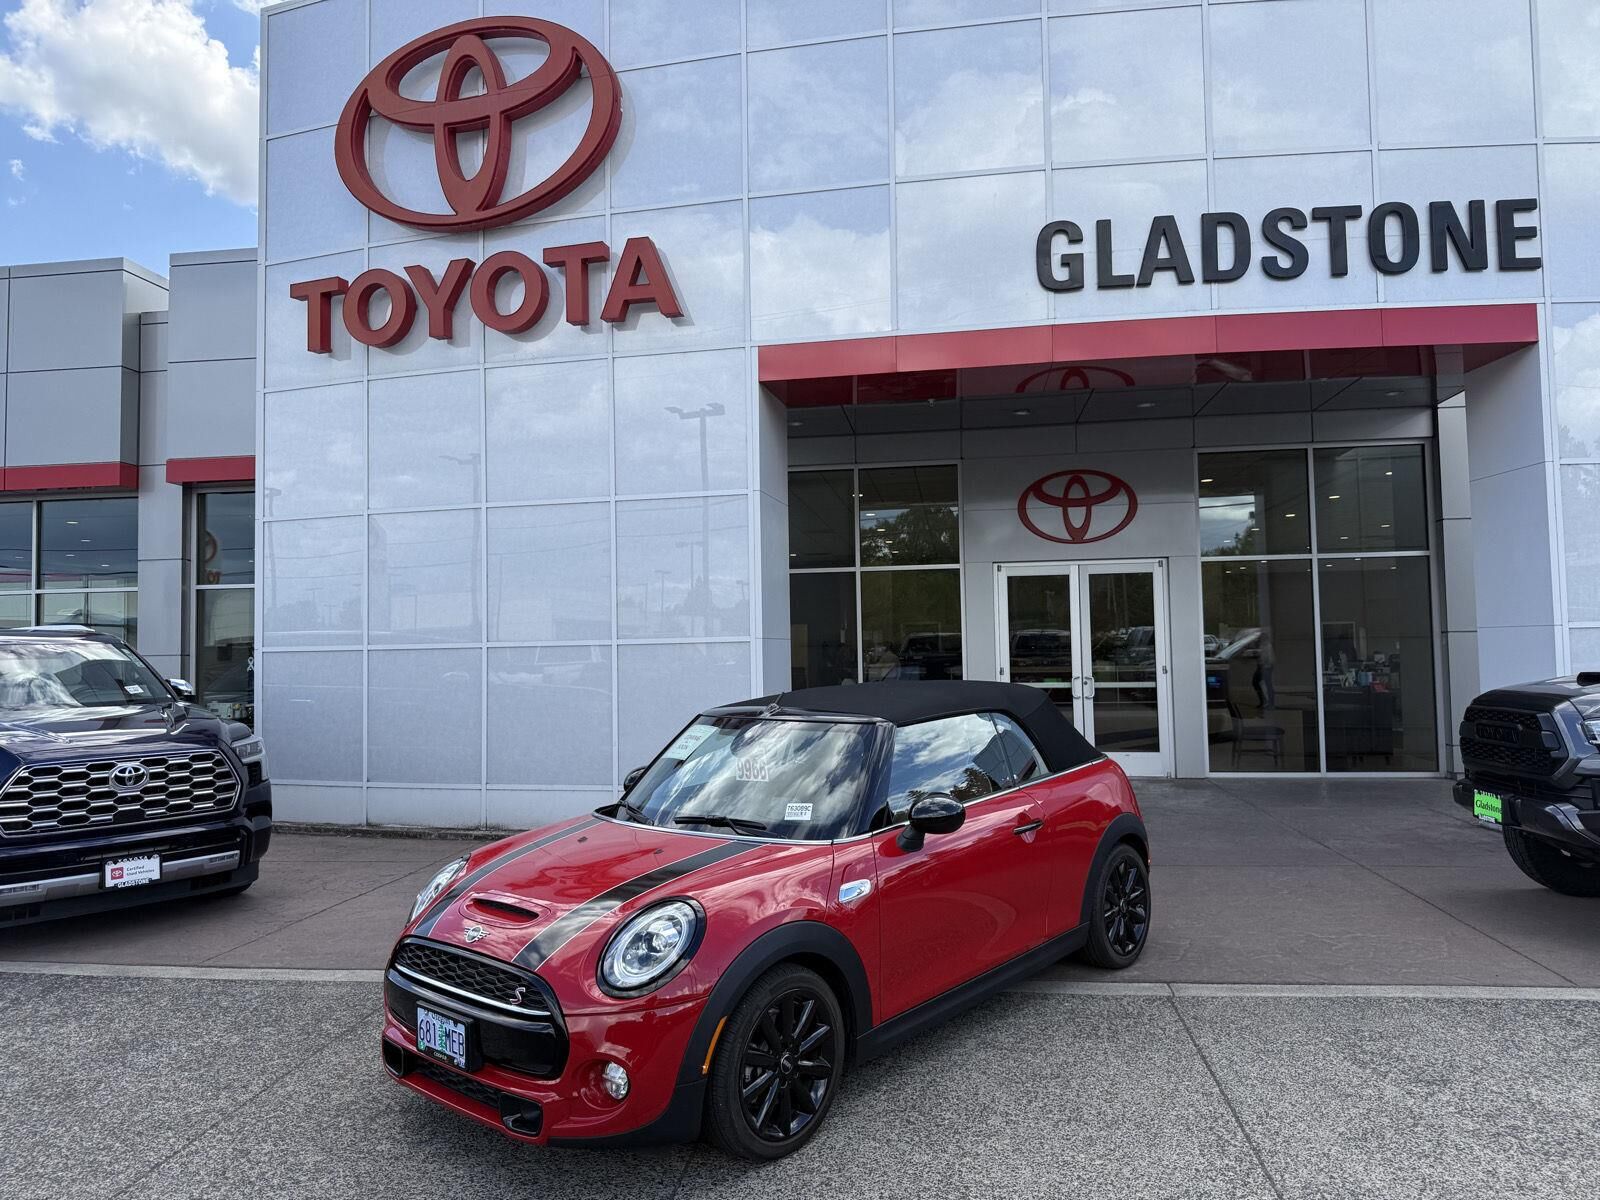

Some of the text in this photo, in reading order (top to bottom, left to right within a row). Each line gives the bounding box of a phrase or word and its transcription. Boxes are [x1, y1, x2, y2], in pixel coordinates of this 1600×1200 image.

[1036, 198, 1542, 291] GLADSTONE
[290, 236, 684, 354] TOYOTA
[510, 987, 525, 1004] S
